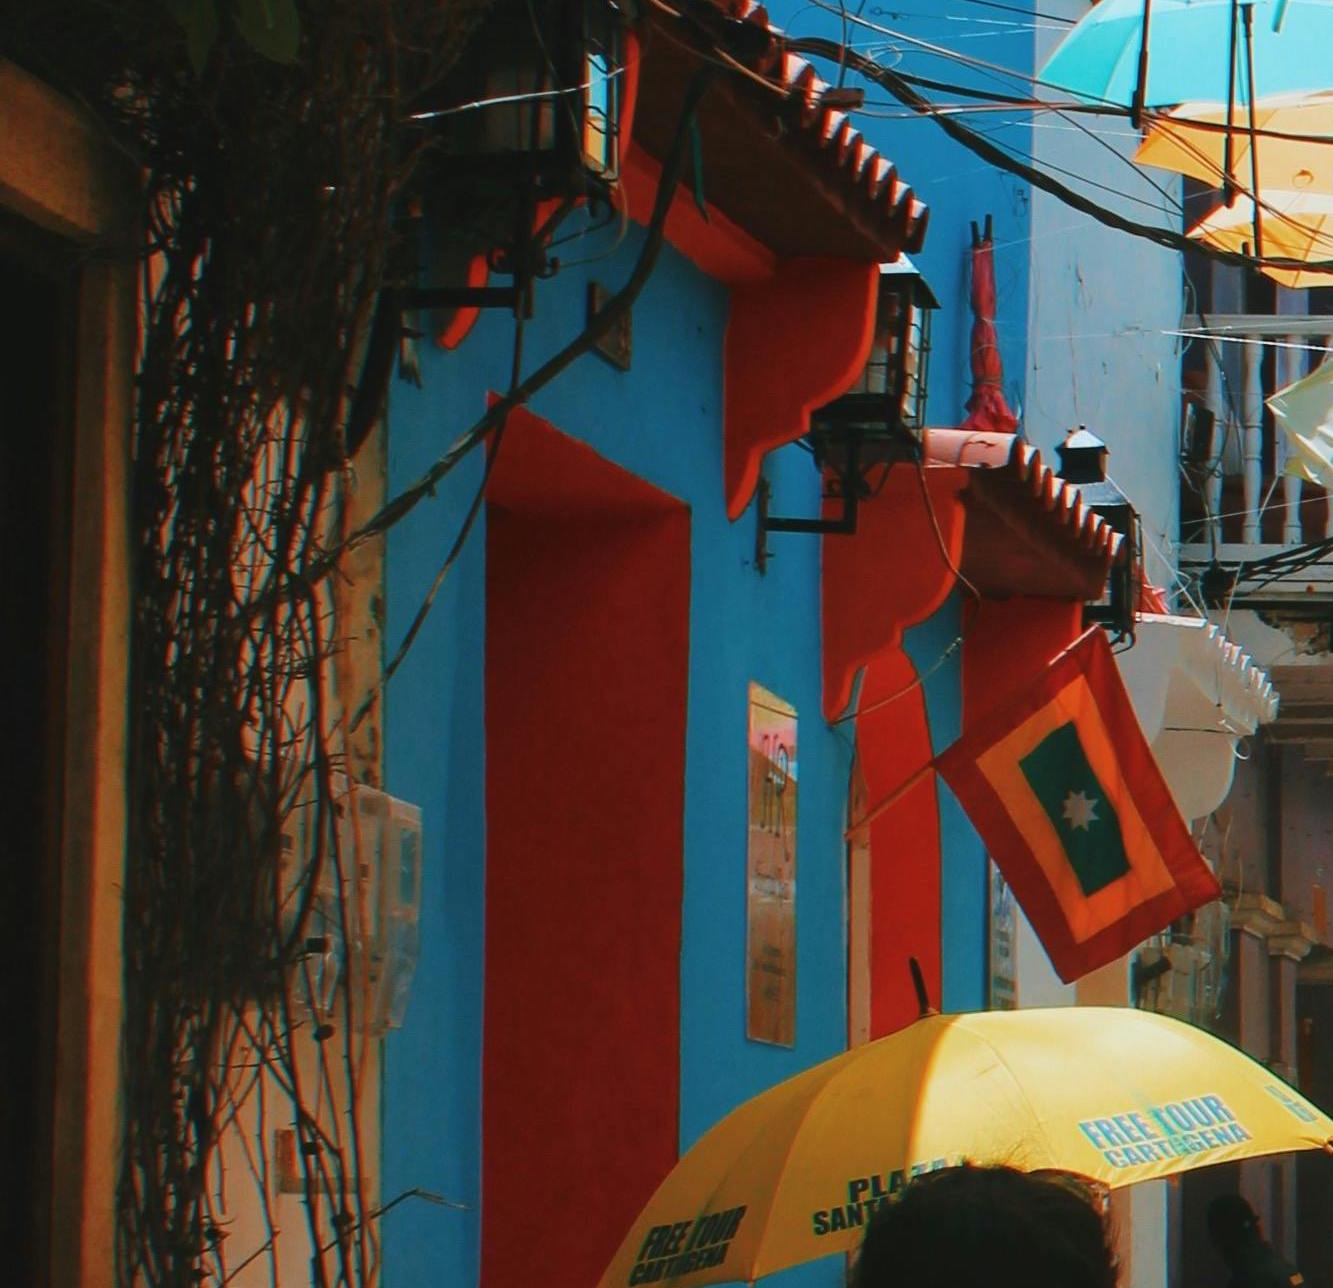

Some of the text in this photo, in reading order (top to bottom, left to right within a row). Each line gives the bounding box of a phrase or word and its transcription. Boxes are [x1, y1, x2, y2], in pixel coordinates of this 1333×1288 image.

[1078, 1112, 1159, 1149] FREE
[1150, 1095, 1235, 1137] TOUR
[1104, 1123, 1253, 1168] CARTAGENA
[636, 1205, 748, 1264] FREE TOUR
